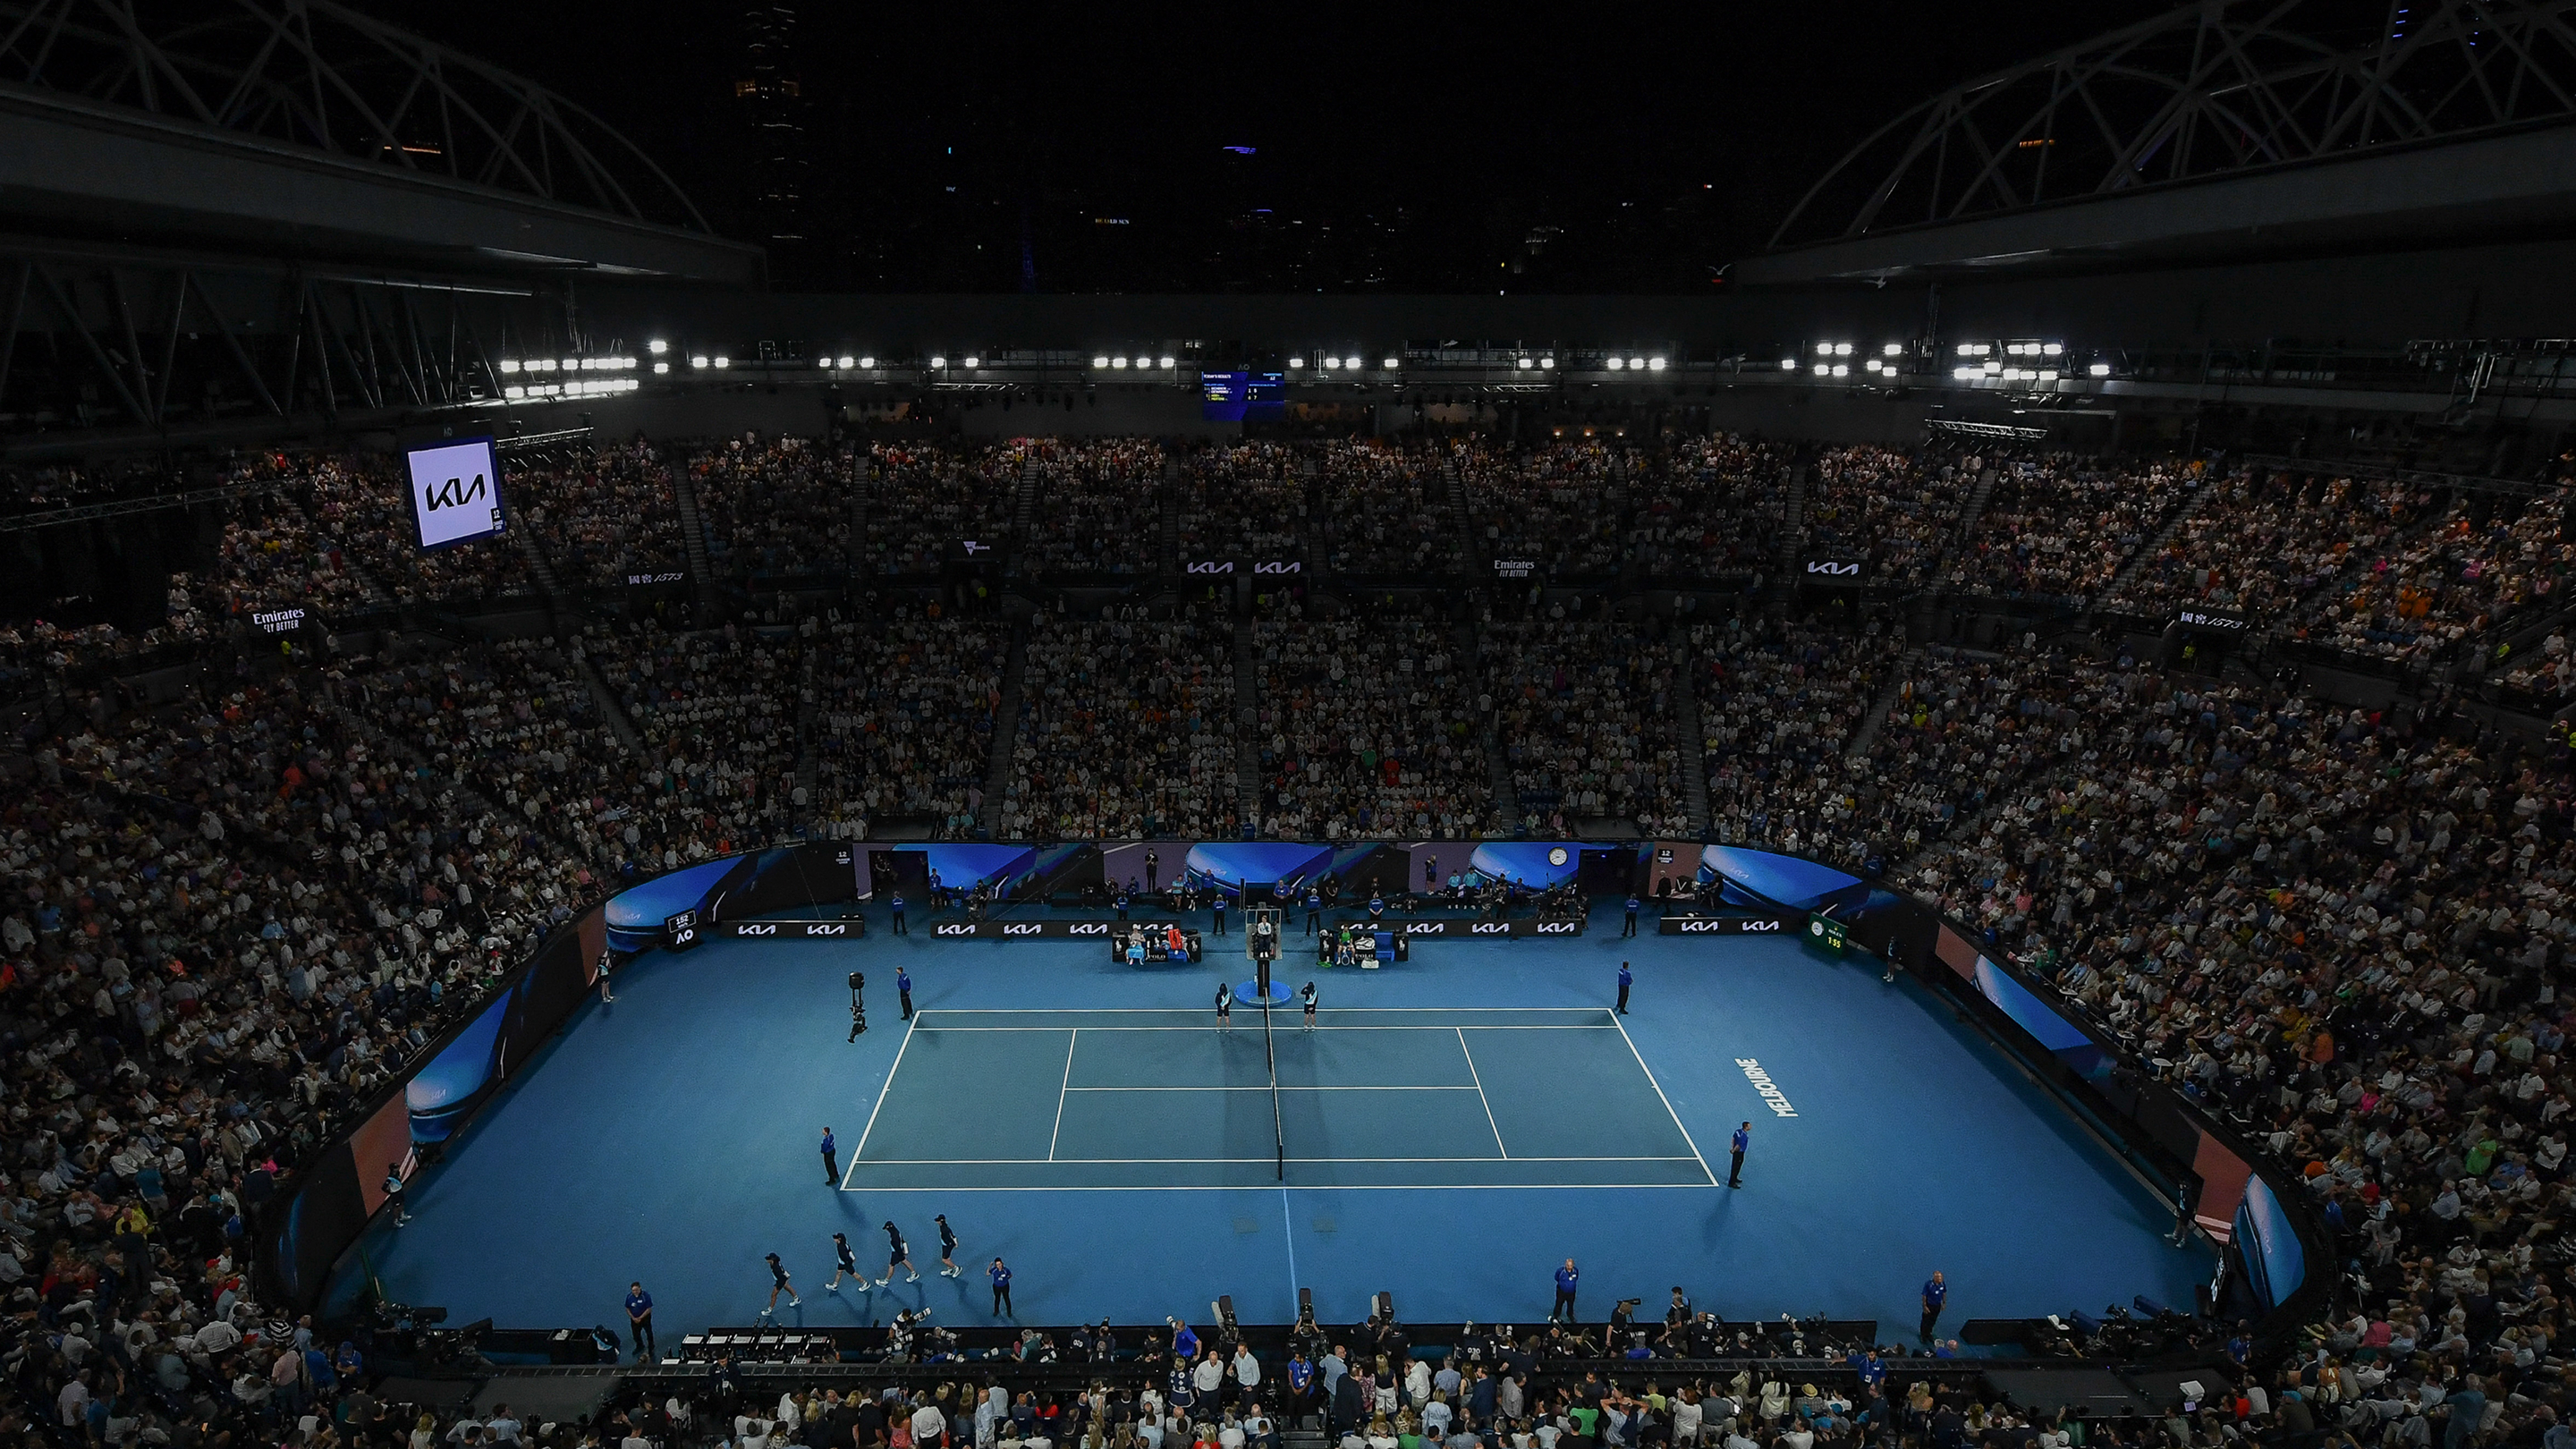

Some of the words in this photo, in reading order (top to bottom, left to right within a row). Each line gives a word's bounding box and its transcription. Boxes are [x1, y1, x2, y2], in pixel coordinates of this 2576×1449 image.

[425, 474, 486, 511] KIA
[493, 509, 501, 519] 12
[1187, 562, 1233, 573] KIA
[1254, 562, 1301, 573] KIA
[1494, 559, 1535, 569] Emirates
[1807, 560, 1859, 576] KIA
[252, 608, 305, 625] Emirates
[276, 619, 300, 632] BETTER
[738, 925, 776, 935] KIA
[807, 925, 845, 935] KIA
[938, 924, 976, 935] KIA
[1004, 924, 1042, 935] KIA
[1070, 924, 1108, 934] KIA
[1407, 923, 1444, 933] KIA
[1472, 923, 1509, 933] KIA
[1537, 922, 1575, 933] KIA
[1681, 921, 1718, 931] KIA
[1742, 921, 1779, 931] KIA
[676, 929, 694, 945] AO
[1734, 1058, 1799, 1117] MELBOURNE
